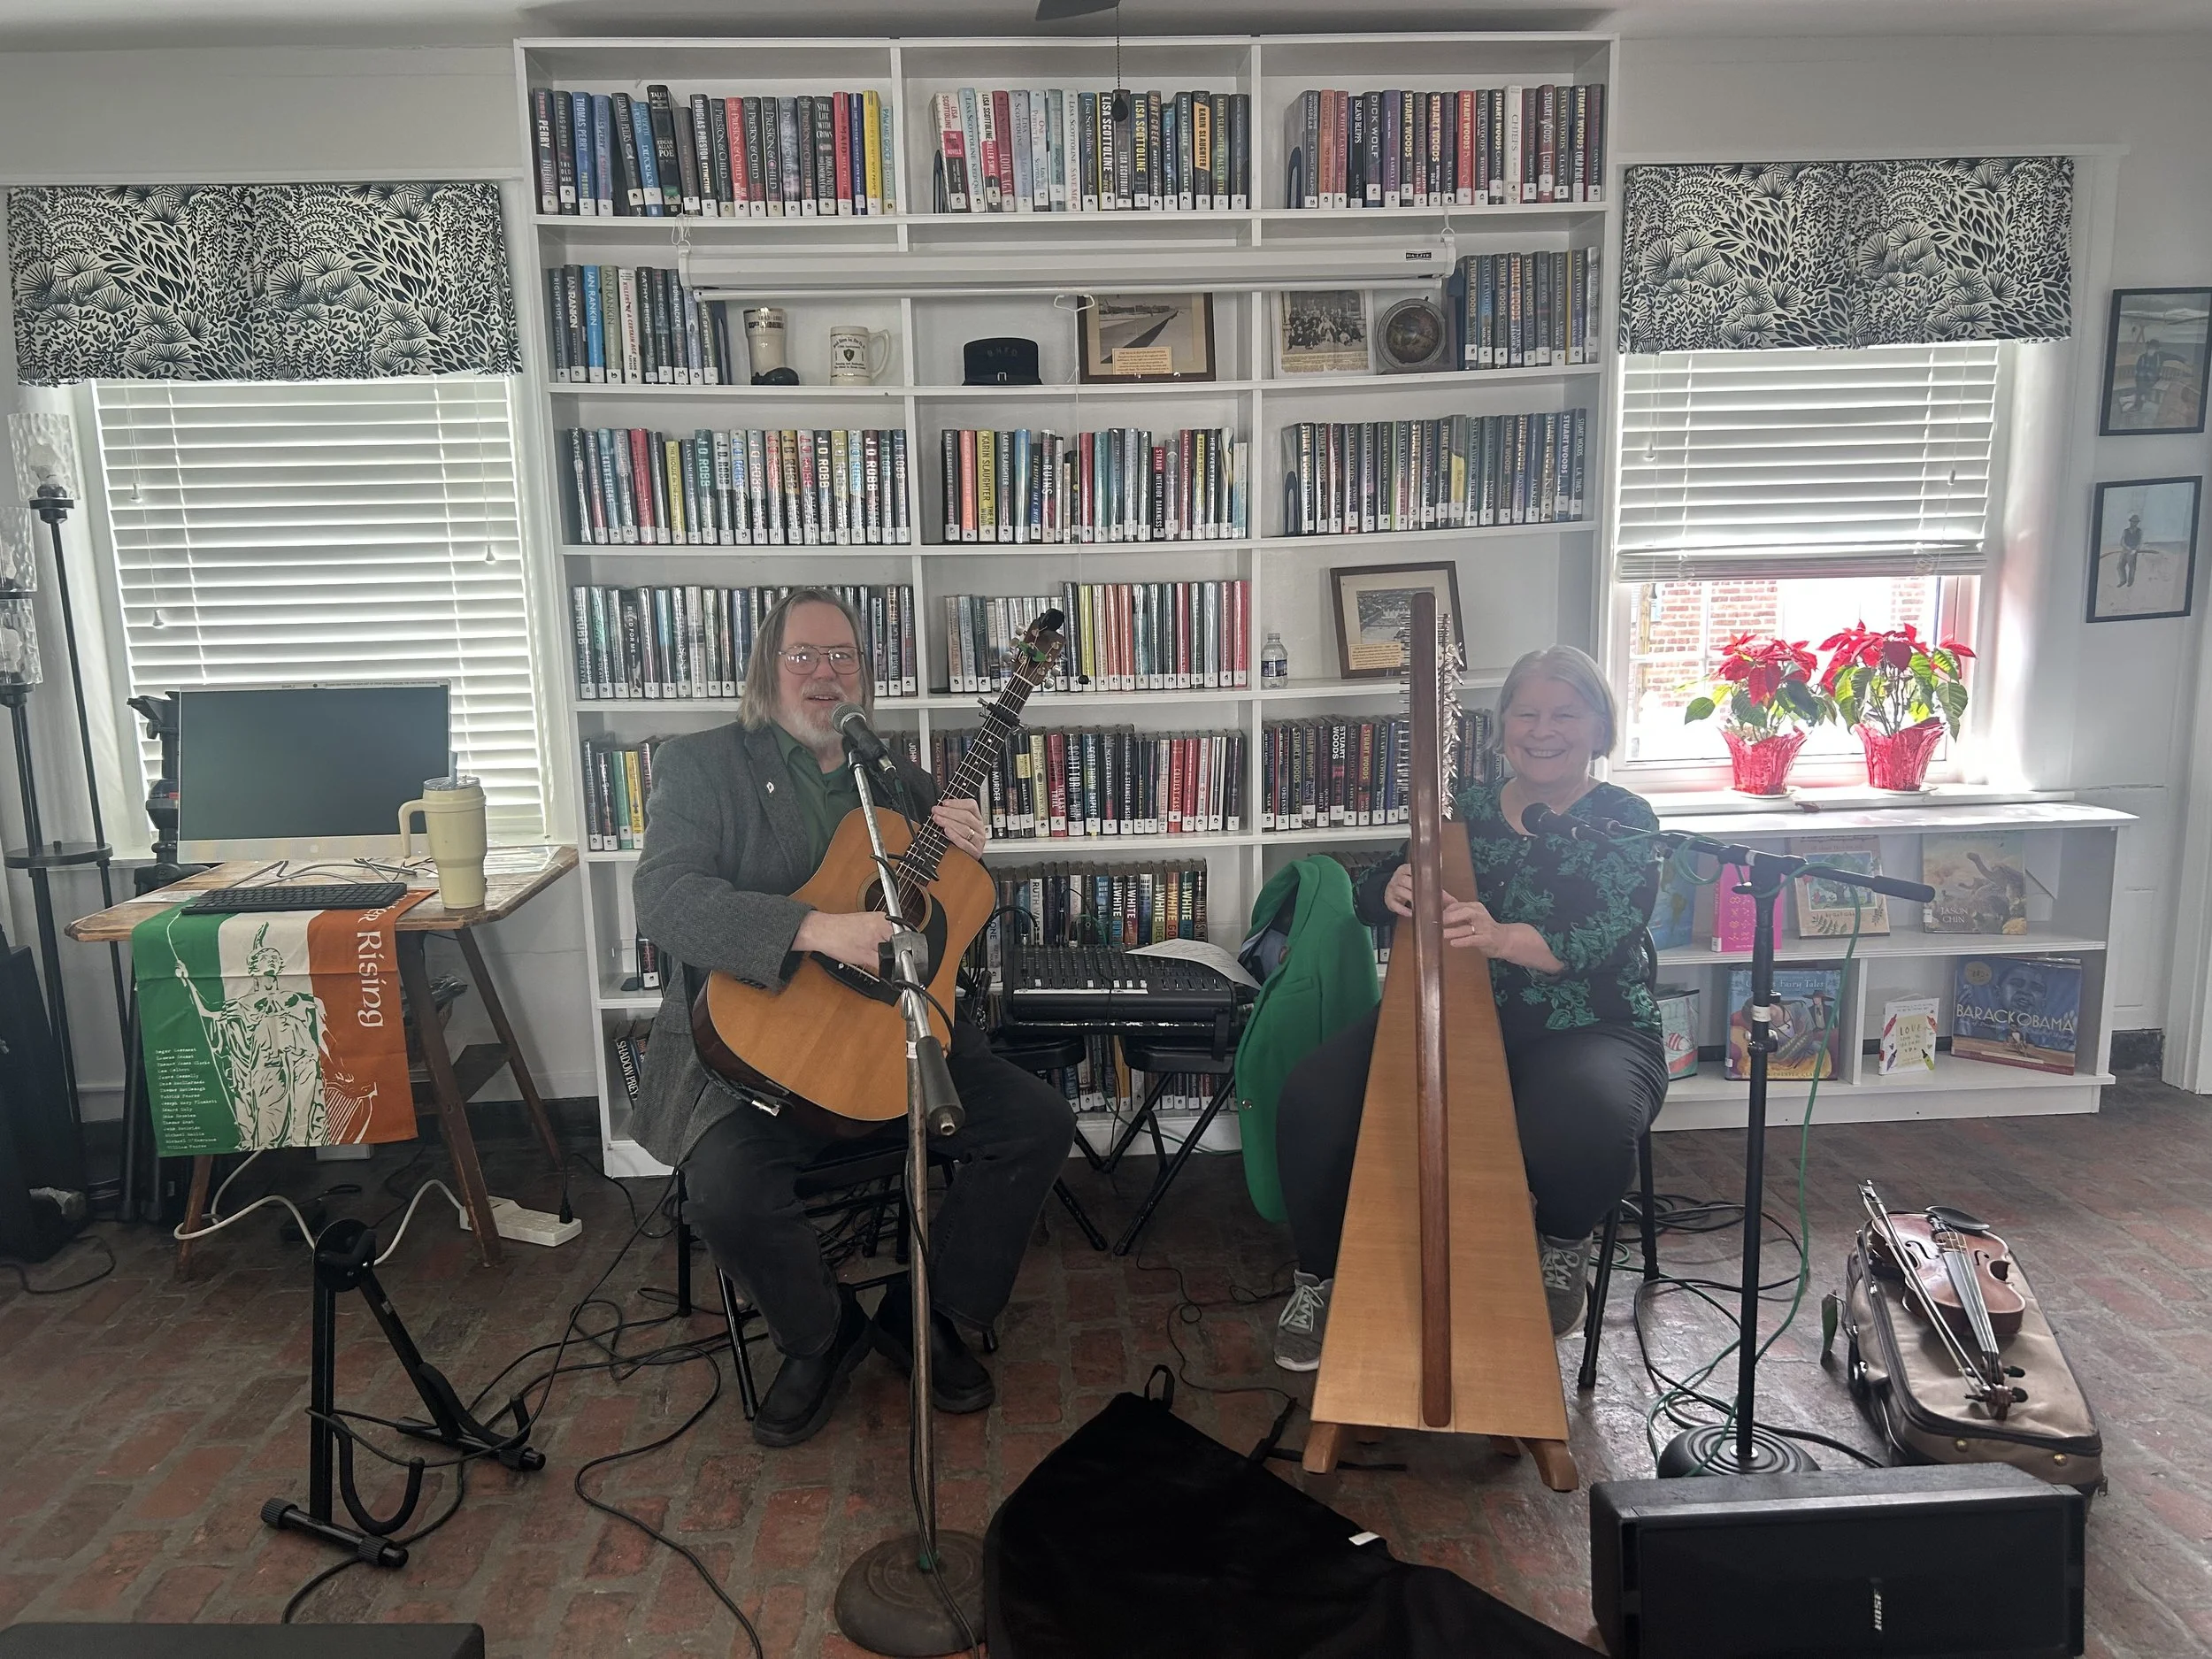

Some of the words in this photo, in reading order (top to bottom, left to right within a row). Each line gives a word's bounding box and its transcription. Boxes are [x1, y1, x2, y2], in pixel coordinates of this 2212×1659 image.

[576, 98, 586, 127] THOMAS
[695, 100, 705, 128] DOUGLAS
[818, 103, 830, 111] STILL
[818, 111, 829, 120] LIFE
[942, 96, 952, 129] SCOTTOLINE
[1102, 96, 1111, 116] LISA
[1135, 99, 1145, 120] LISA
[1150, 96, 1160, 113] DIRT
[1404, 93, 1413, 123] STUART
[539, 120, 549, 148] PERRY
[715, 109, 725, 142] PRESTON
[731, 113, 740, 142] PRESTON
[749, 112, 757, 143] PRESTON
[765, 112, 774, 150] PRESTON
[967, 113, 977, 161] SCOTTOLINE
[983, 107, 993, 139] SCOTTOLINE
[1151, 113, 1160, 146] CREEK
[579, 130, 588, 151] PERRY
[697, 129, 708, 160] PRESTON
[1102, 118, 1112, 172] SCOTTOLINE
[1135, 121, 1147, 173] SCOTTOLINE
[1404, 125, 1413, 157] WOODS
[702, 163, 710, 193] EXTINCTION
[733, 154, 742, 180] CHILD
[750, 152, 759, 179] CHILD
[768, 160, 777, 189] CHILD
[1000, 153, 1010, 176] LOOK
[1071, 188, 1077, 201] ME
[1511, 257, 1521, 288] STUART
[568, 289, 577, 328] RANKIN
[588, 290, 597, 326] RANKIN
[605, 288, 614, 325] RANKIN
[1511, 290, 1520, 321] WOODS
[699, 458, 710, 487] ROBB
[818, 459, 830, 488] ROBB
[866, 461, 878, 491] ROBB
[895, 454, 905, 479] ROBB
[1042, 465, 1052, 495] RUINS
[1302, 455, 1311, 482] WOODS
[631, 643, 635, 653] ME
[1068, 745, 1080, 770] SCOTT
[1087, 746, 1096, 766] SCOTT
[992, 771, 1001, 801] MURDER
[1087, 768, 1096, 789] TUROW
[1127, 890, 1136, 918] WHITE
[1155, 892, 1164, 922] WHITE
[1168, 891, 1177, 920] WHITE
[1182, 890, 1192, 920] WHITE
[1941, 906, 1968, 915] JASON
[1780, 979, 1801, 989] Fairy
[1901, 1024, 1921, 1035] LOVE
[1956, 1003, 2016, 1025] BARACK
[2016, 1012, 2075, 1033] OBAMA
[617, 1041, 634, 1075] SHADOW
[626, 1076, 639, 1094] PREY
